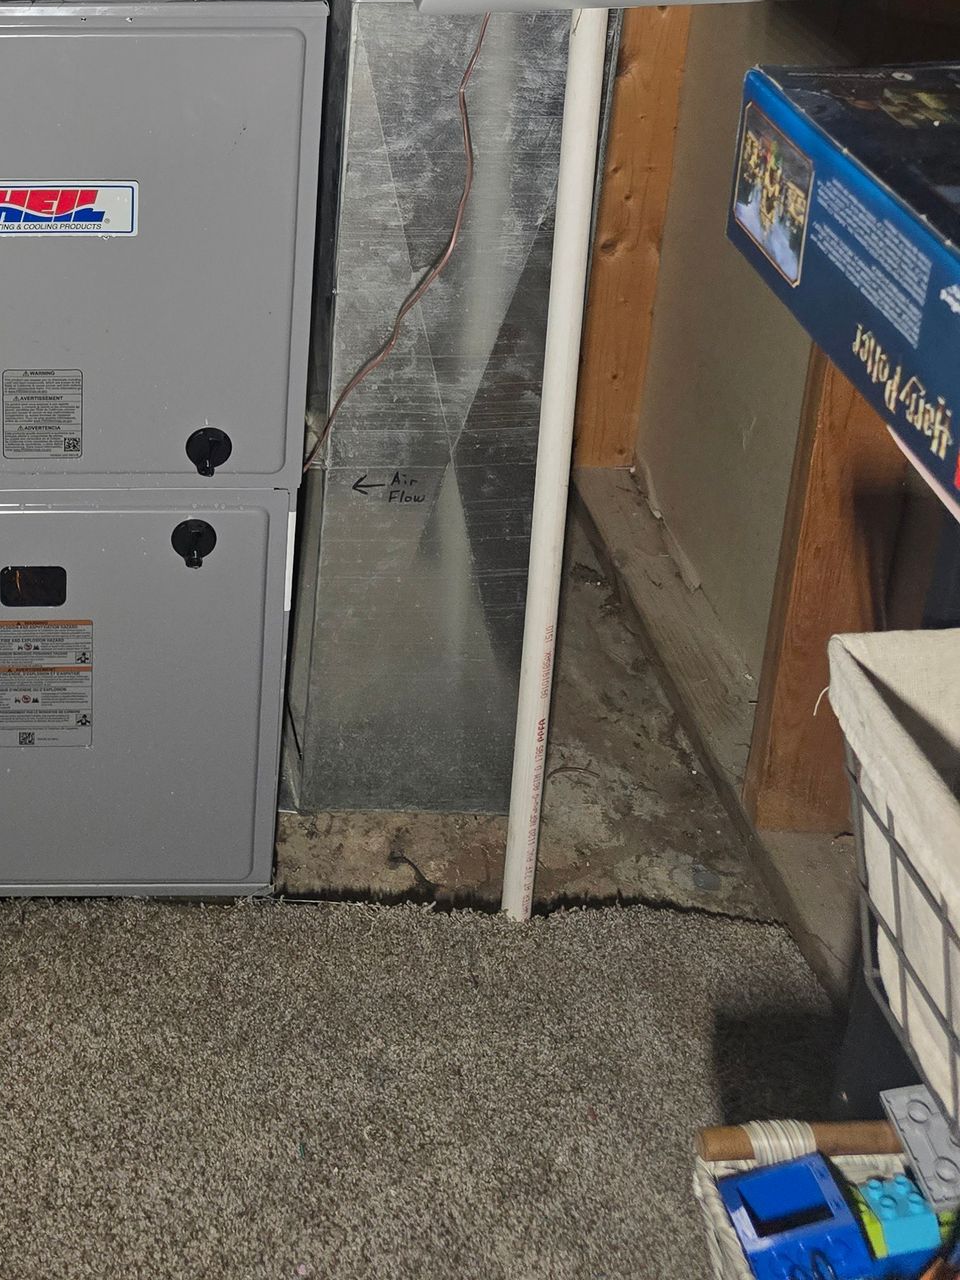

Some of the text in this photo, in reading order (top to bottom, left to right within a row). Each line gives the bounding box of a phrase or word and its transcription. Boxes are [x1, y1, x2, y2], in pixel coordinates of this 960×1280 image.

[852, 322, 903, 415] Potter
[899, 376, 953, 460] Harry
[388, 490, 426, 503] Flow
[390, 471, 418, 486] Air
